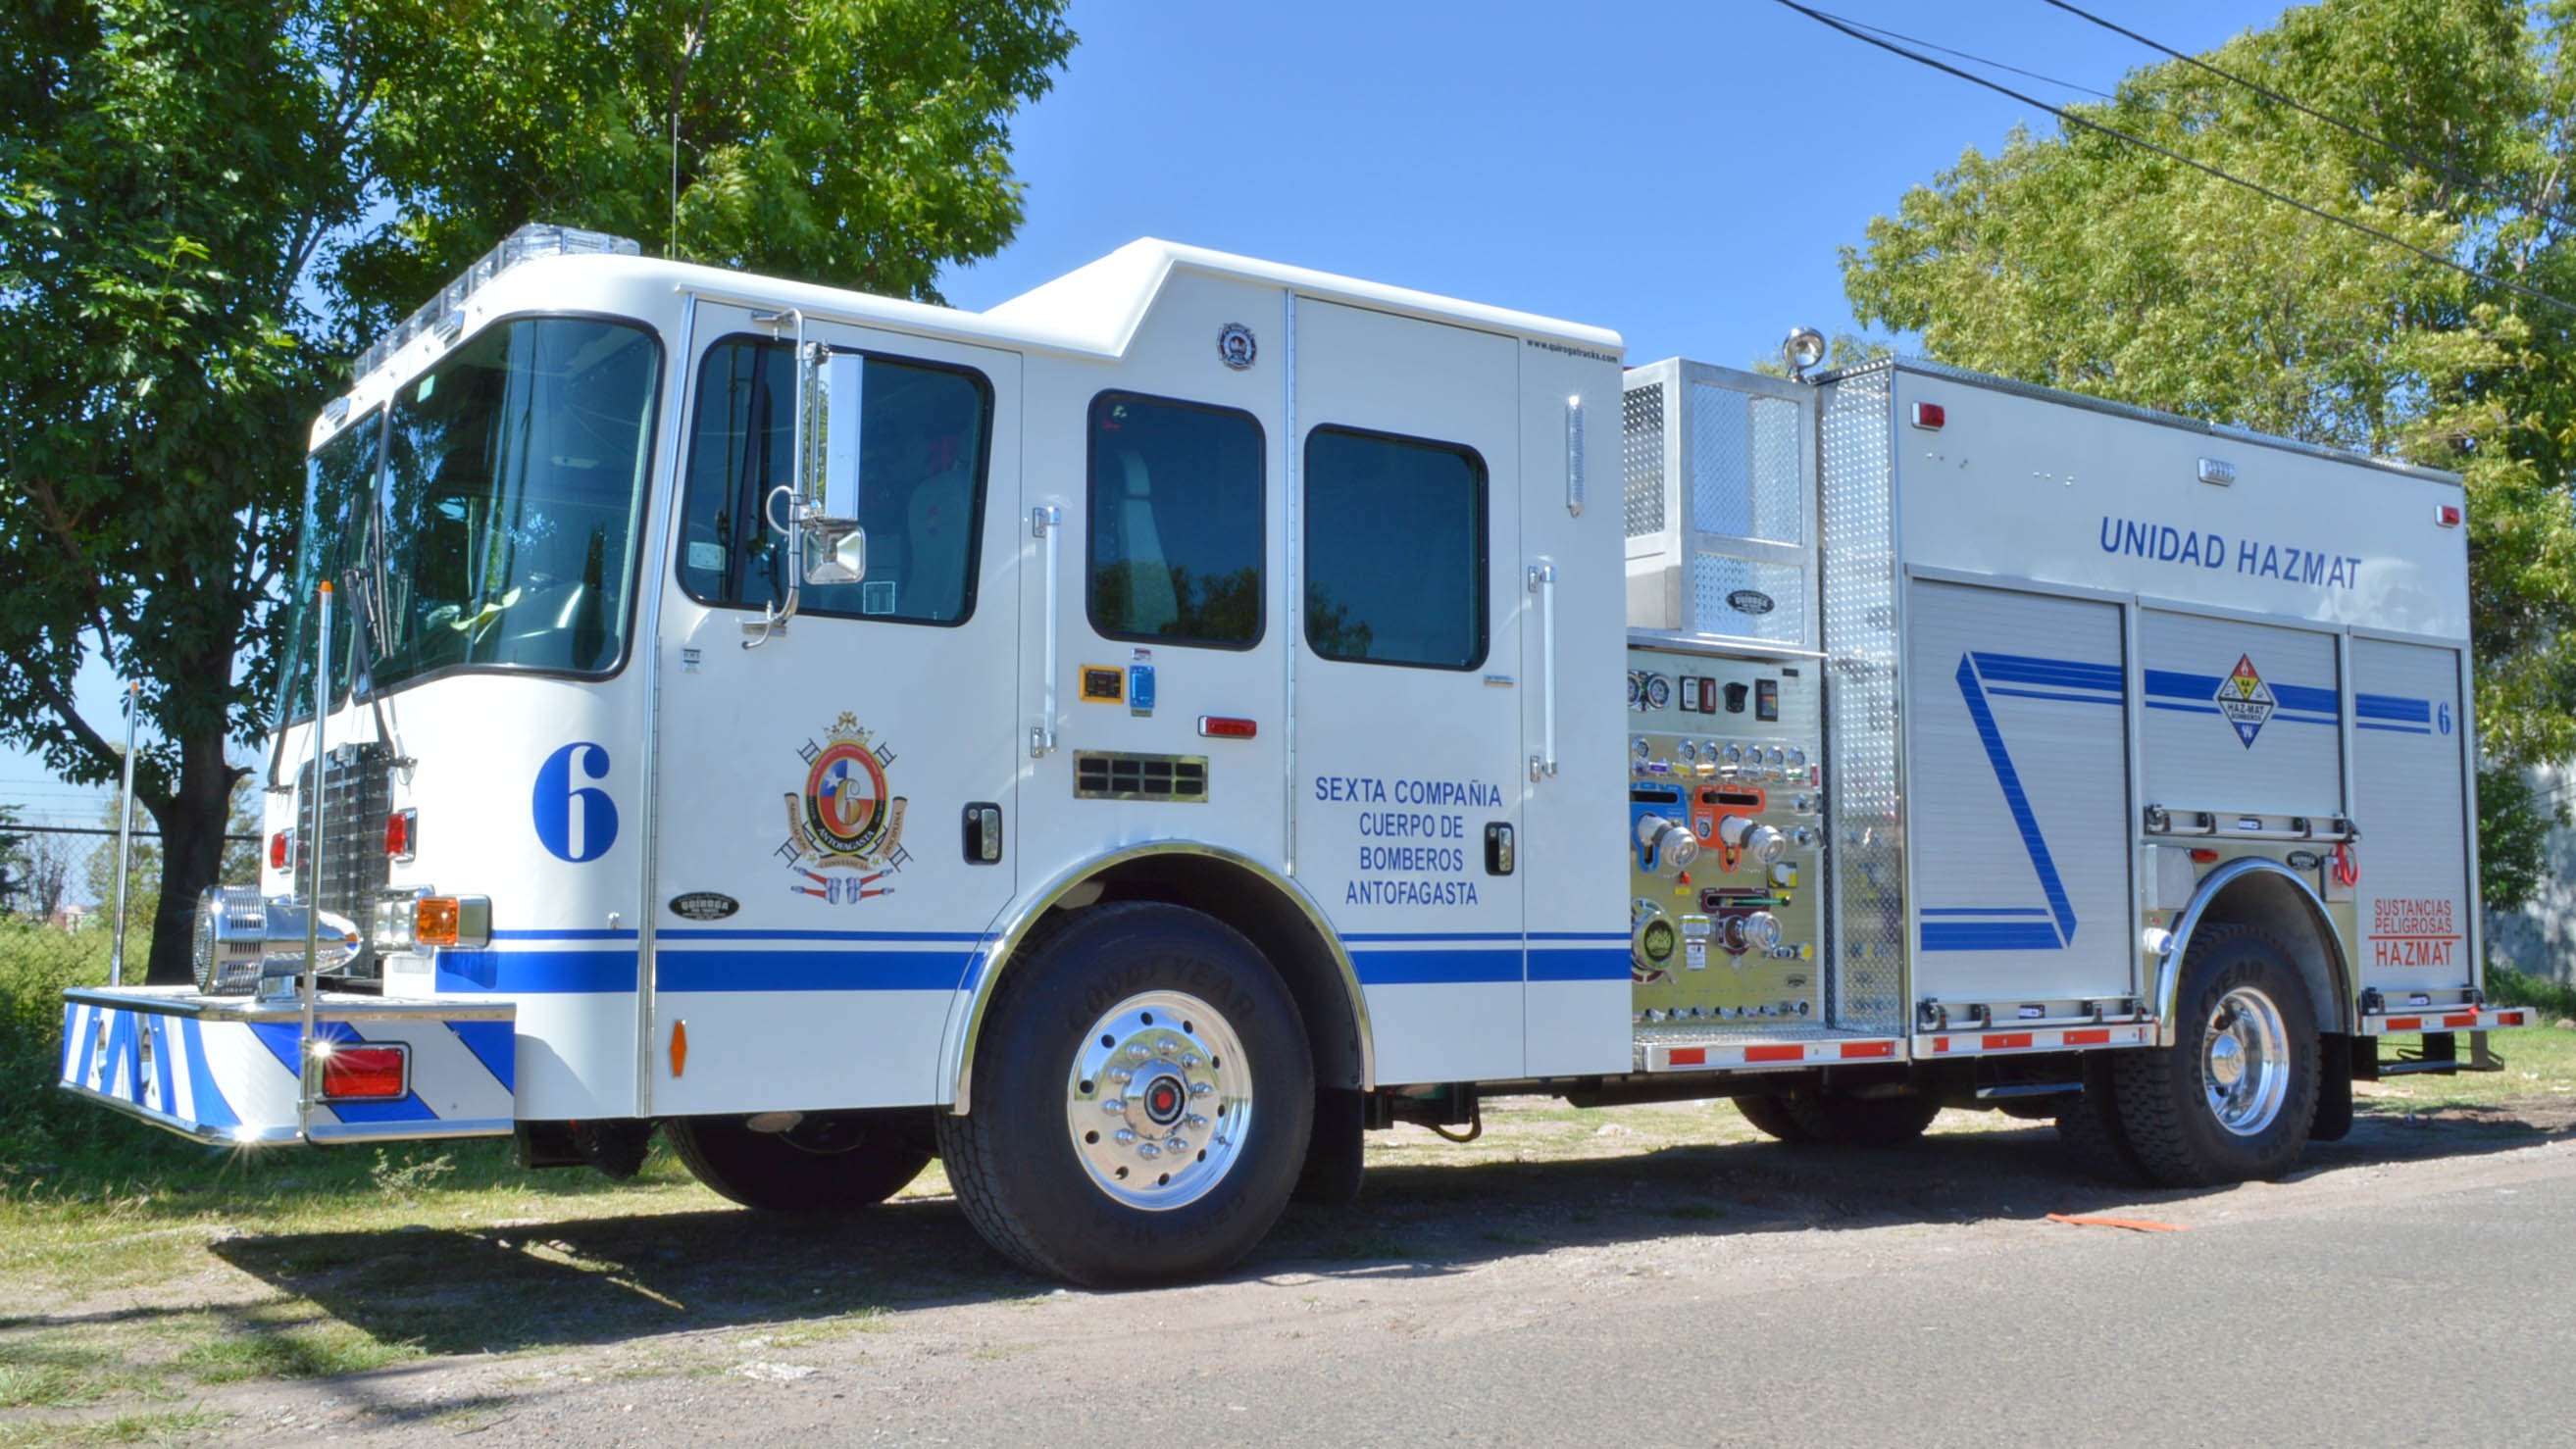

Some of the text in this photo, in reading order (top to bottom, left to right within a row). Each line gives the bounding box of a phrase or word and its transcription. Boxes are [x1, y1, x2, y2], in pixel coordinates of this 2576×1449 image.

[1527, 339, 1618, 364] www.quirogatrucks.com
[2100, 517, 2362, 589] UNIDAD HAZMAT
[2437, 700, 2452, 736] 6
[532, 741, 619, 864] 6
[834, 778, 863, 827] 6
[1315, 776, 1502, 807] SEXTA COMPAÑIA
[1359, 812, 1464, 838] CUERPO DE
[817, 827, 875, 853] ANTOFAGASTA
[1360, 847, 1464, 872] BOMBEROS
[1345, 880, 1478, 905] ANTOFAGASTA
[2375, 899, 2451, 918] SUSTANCIAS
[2375, 918, 2452, 934] PELIGROSAS
[2376, 940, 2453, 966] HAZMAT
